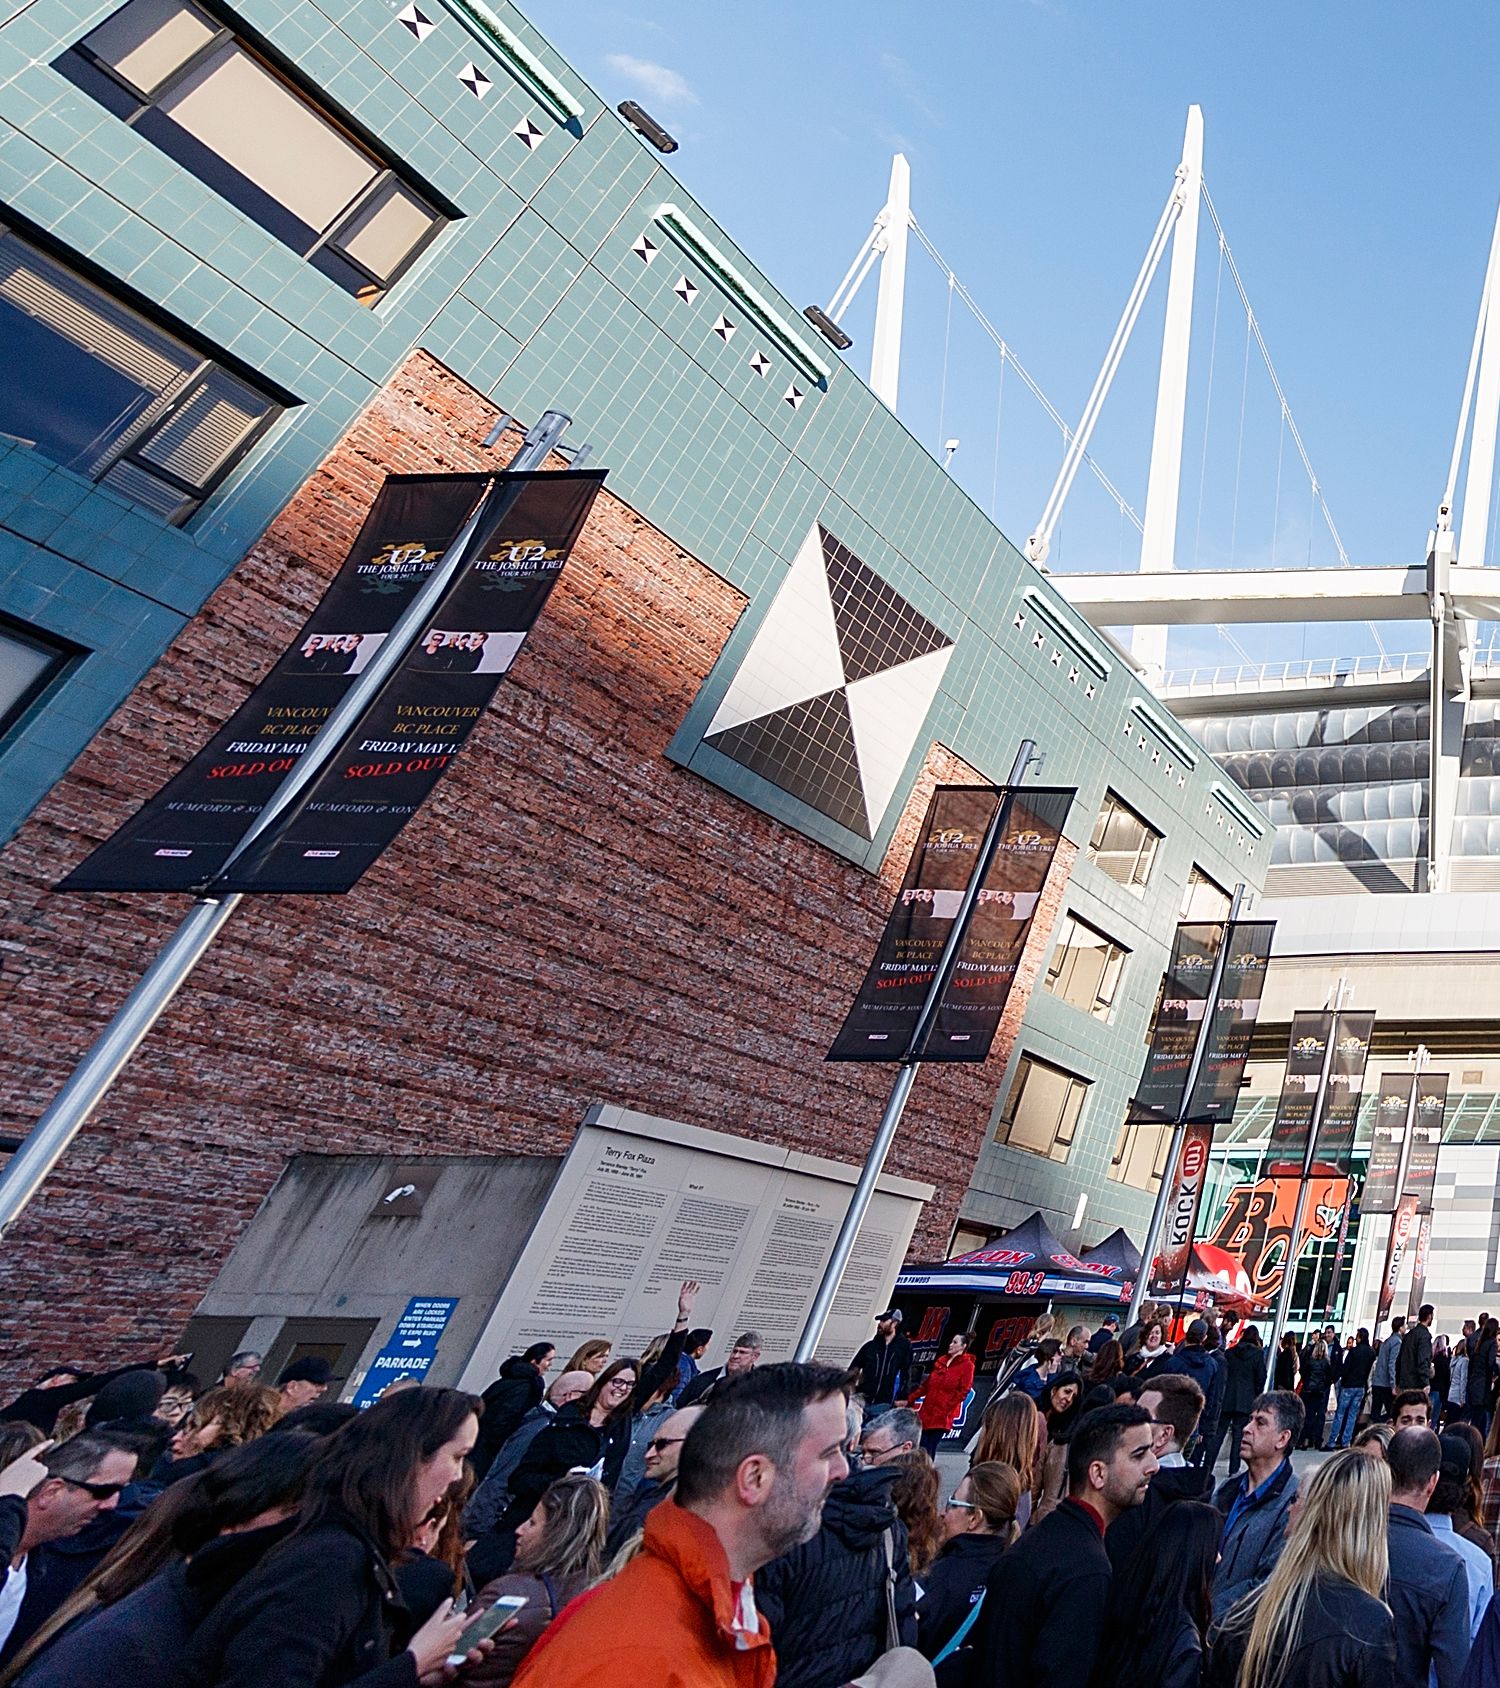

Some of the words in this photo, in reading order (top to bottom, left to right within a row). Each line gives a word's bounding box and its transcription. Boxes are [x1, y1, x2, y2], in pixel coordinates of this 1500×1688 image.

[389, 548, 427, 564] U2
[508, 546, 547, 562] U2
[357, 564, 379, 574] THE
[378, 563, 417, 574] JOSHUA
[418, 561, 438, 571] TRE
[474, 560, 497, 570] THE
[496, 560, 540, 571] JOSHUA
[267, 707, 333, 717] VANCOUV
[395, 706, 480, 717] VANCOUVER
[260, 724, 279, 735] BC
[392, 723, 415, 735] BC
[415, 724, 460, 735] PLACE
[226, 741, 281, 753] FRIDAY
[280, 743, 308, 753] MAY
[359, 740, 417, 753] FRIDAY
[414, 743, 449, 753] MAY
[207, 760, 265, 779] SOLD
[265, 758, 294, 773] OU
[344, 762, 403, 779] SOLD
[405, 756, 452, 773] OUT
[166, 802, 231, 813] MUMFORD
[233, 804, 247, 813] &
[247, 805, 263, 813] SO
[306, 802, 374, 813] MUMFORD
[375, 804, 387, 813] &
[388, 805, 416, 814] SON
[939, 832, 964, 843] U2
[1017, 834, 1042, 845] U2
[895, 939, 944, 948] VANCOUVER
[969, 939, 1020, 949] VANCOUVER
[880, 963, 910, 971] FRIDAY
[910, 964, 929, 972] MAY
[956, 962, 988, 971] FRIDAY
[988, 964, 1007, 972] MAY
[876, 976, 907, 989] SOLD
[909, 972, 934, 985] OUT
[953, 978, 986, 989] SOLD
[987, 973, 1010, 985] OUT
[861, 1004, 899, 1012] MUMFORD
[605, 1146, 622, 1159] Terry
[622, 1150, 636, 1161] Fox
[636, 1153, 656, 1165] Plaza
[1004, 1270, 1045, 1294] 99.3
[374, 1356, 431, 1369] PARKADE
[360, 1400, 371, 1409] TO
